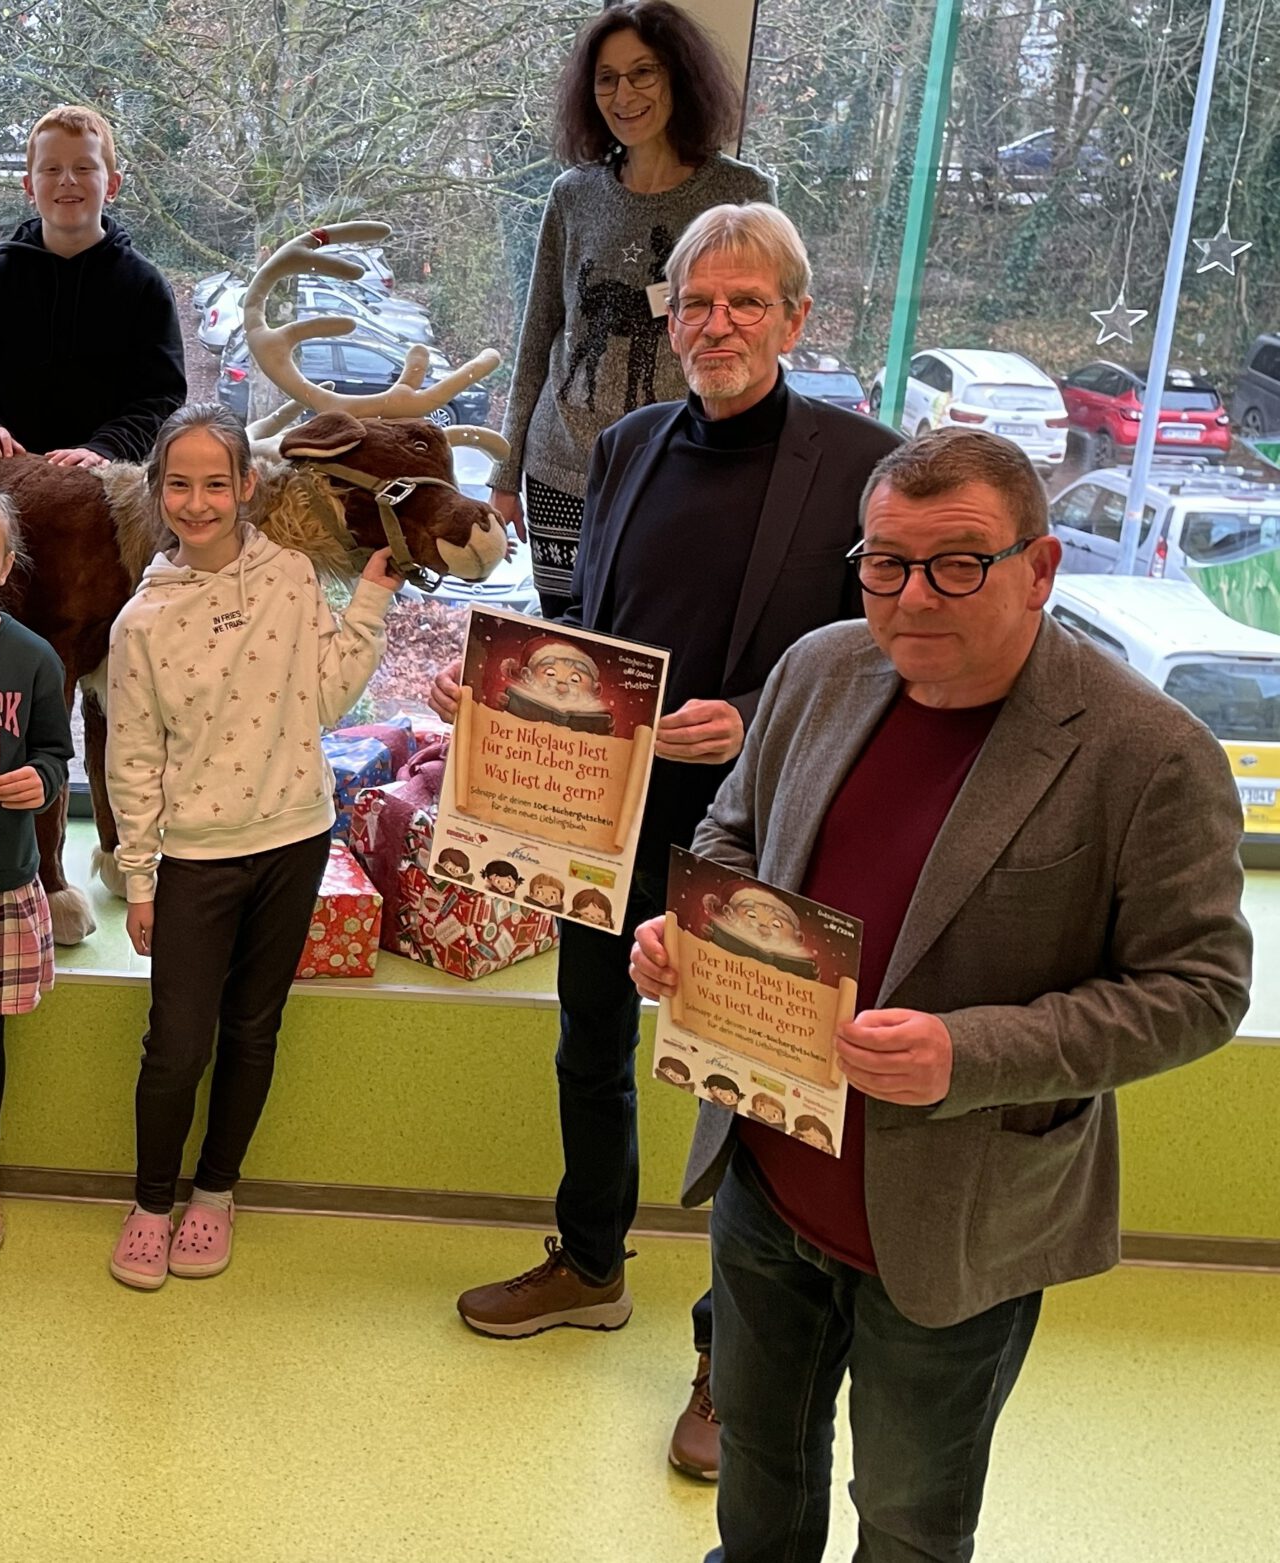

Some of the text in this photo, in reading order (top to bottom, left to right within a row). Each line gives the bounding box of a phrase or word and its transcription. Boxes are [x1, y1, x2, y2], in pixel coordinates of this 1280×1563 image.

[213, 610, 242, 624] IN FRIES
[213, 625, 224, 634] WE
[481, 736, 502, 754] für
[505, 746, 531, 761] sein
[536, 749, 573, 770] Leben
[490, 720, 607, 761] Der Nikolaus liest
[485, 763, 604, 802] Was liest du gern?
[470, 785, 613, 825] Schnapp dir deinen 10€-Büchergutschein
[491, 800, 501, 810] für
[502, 804, 517, 814] dein
[518, 810, 537, 820] neues
[697, 948, 814, 1003] Der Nikolaus liest
[715, 974, 741, 990] sein
[746, 981, 782, 1005] Leben
[697, 984, 814, 1036] Was liest du gern?
